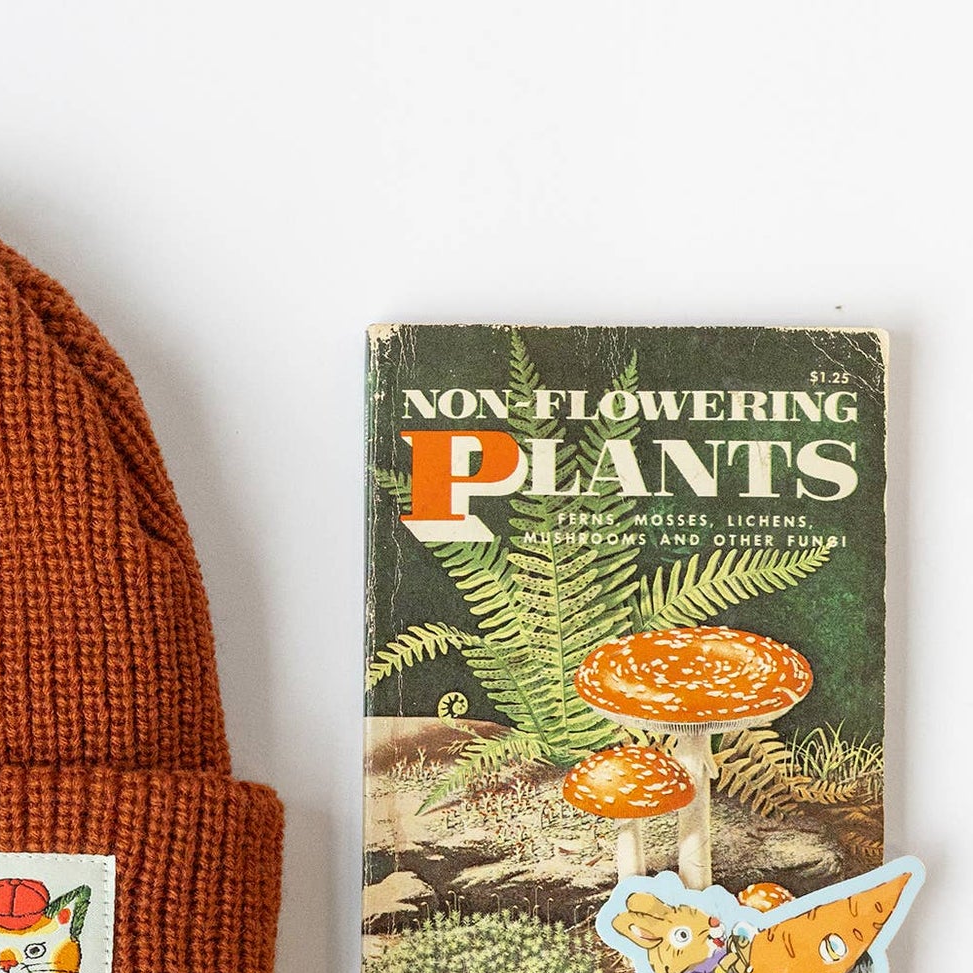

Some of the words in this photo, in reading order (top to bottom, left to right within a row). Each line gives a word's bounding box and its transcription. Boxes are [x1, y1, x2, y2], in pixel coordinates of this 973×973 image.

[810, 371, 850, 386] $1.25
[402, 388, 858, 422] NON-FLOWERING
[400, 430, 859, 541] PLANTS
[558, 512, 621, 527] FERNS,
[634, 513, 714, 528] MOSSES,
[728, 514, 814, 529] LICHENS,
[523, 531, 647, 546] MUSHROOMS
[660, 534, 700, 546] AND
[713, 534, 774, 547] OTHER
[787, 535, 847, 548] FUNGI
